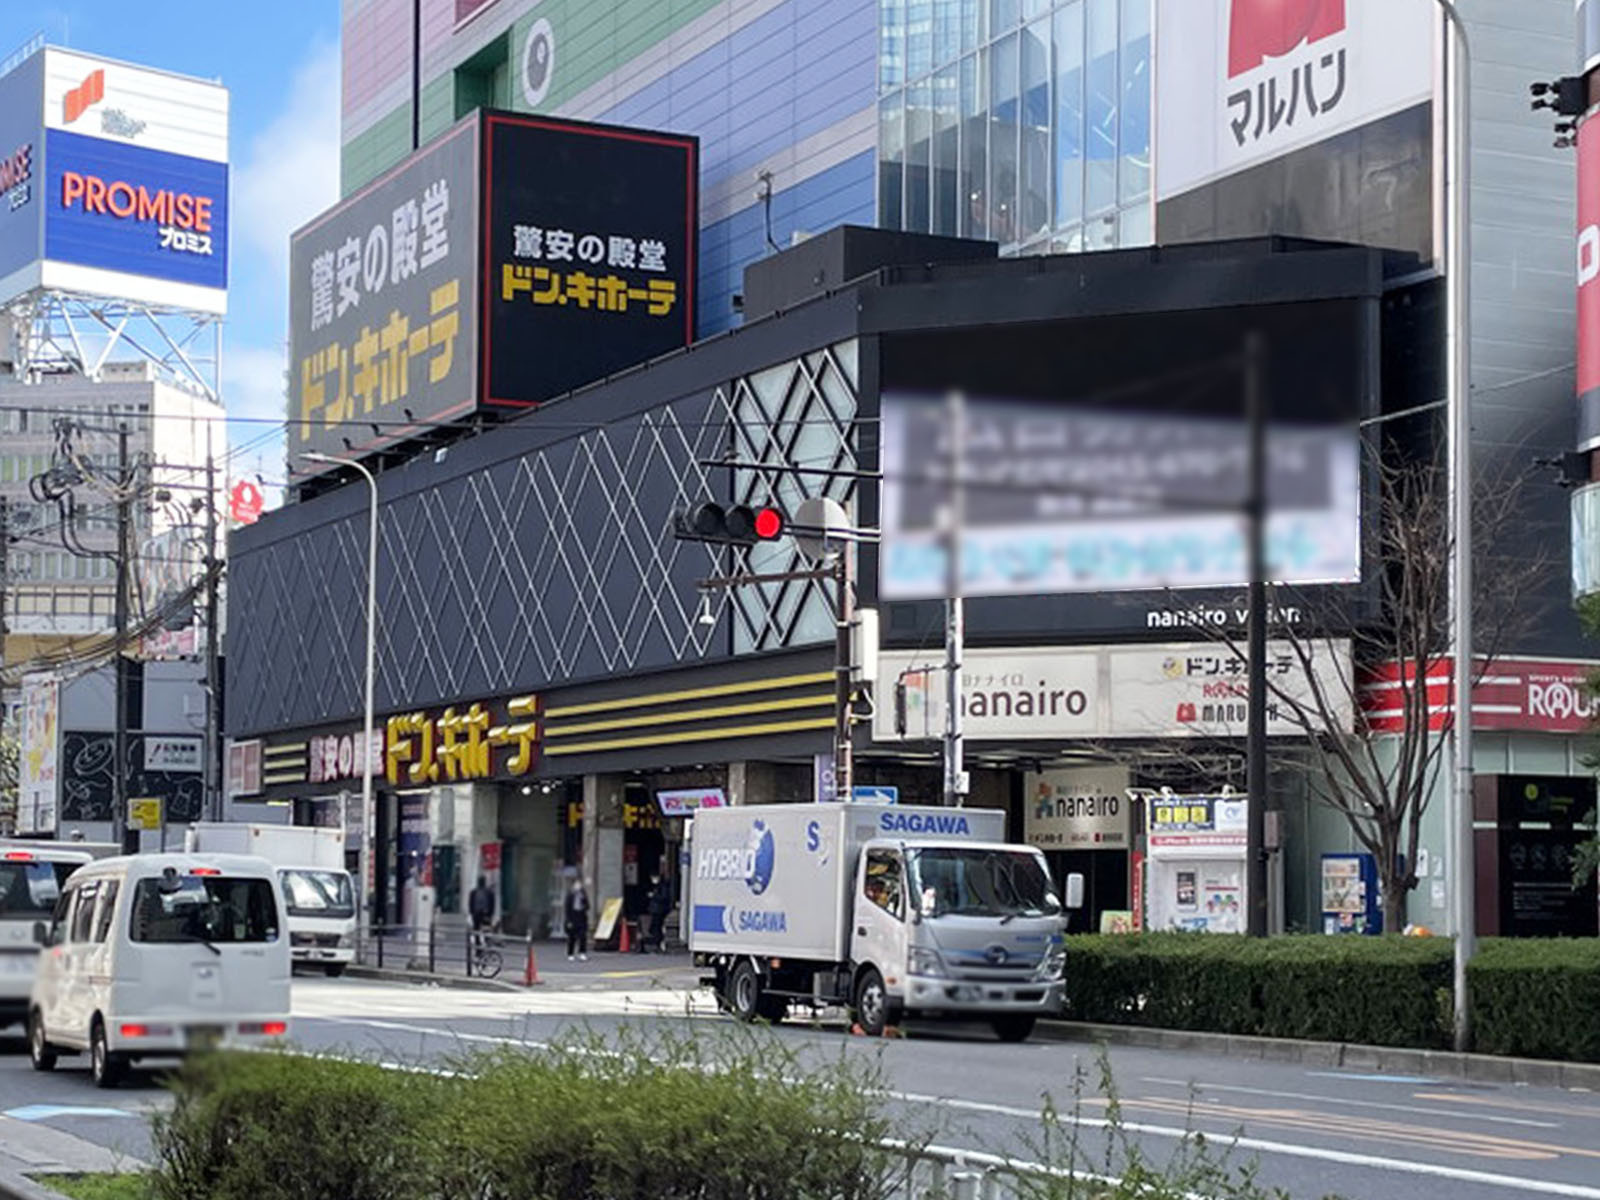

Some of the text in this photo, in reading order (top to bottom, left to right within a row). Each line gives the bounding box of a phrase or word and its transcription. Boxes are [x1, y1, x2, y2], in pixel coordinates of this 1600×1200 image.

[1227, 48, 1346, 147] マルハン
[63, 171, 212, 232] PROMISE
[159, 227, 213, 255] プロミス
[311, 179, 450, 331] 驚安の殿堂
[513, 224, 667, 272] 驚安の殿堂
[1056, 788, 1119, 817] nanairo
[880, 812, 970, 834] SAGAWA
[696, 847, 757, 880] HYBRID
[739, 910, 787, 932] SAGAWA
